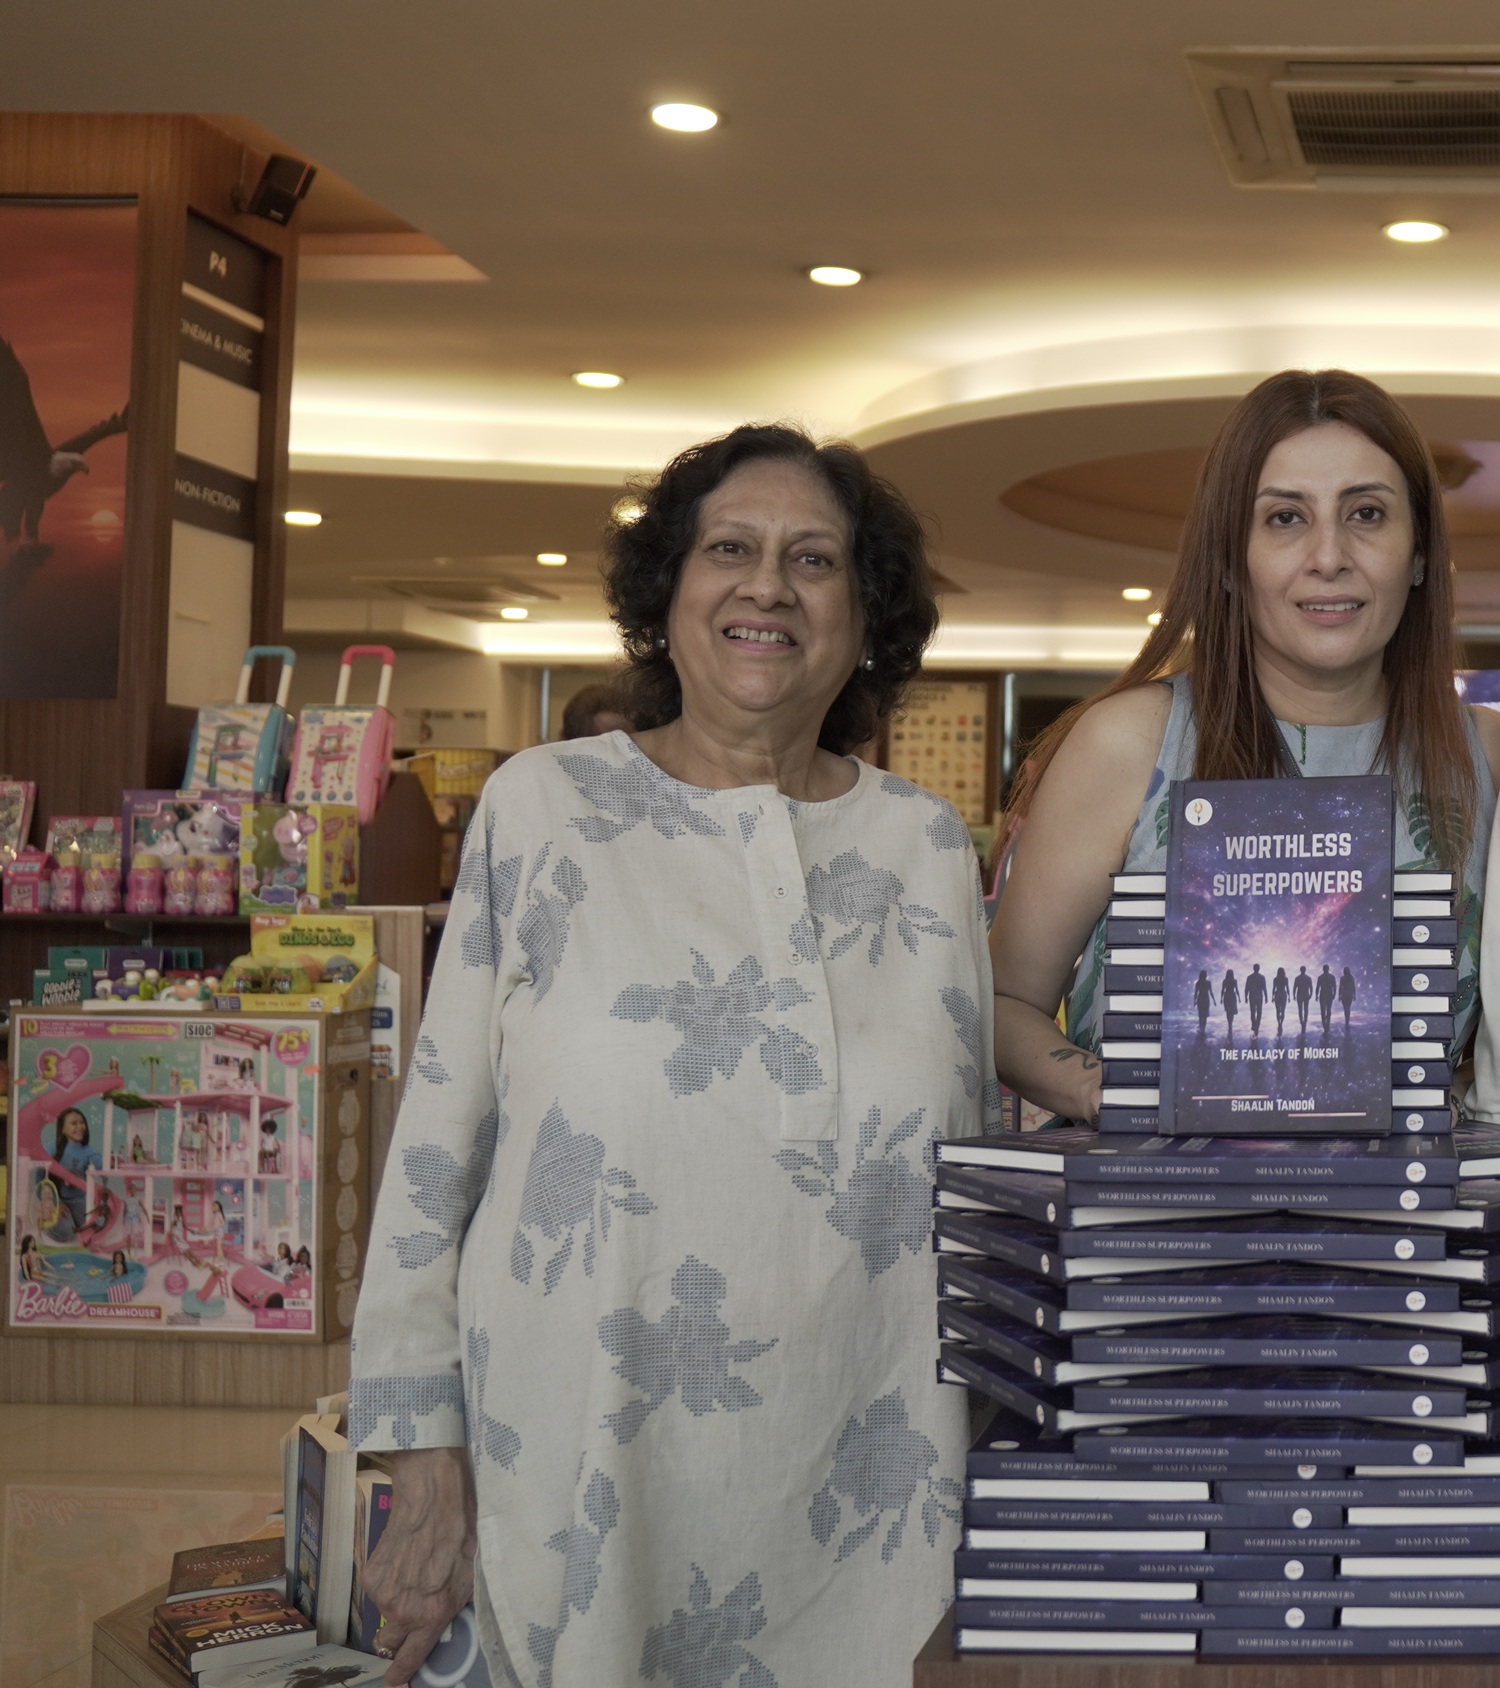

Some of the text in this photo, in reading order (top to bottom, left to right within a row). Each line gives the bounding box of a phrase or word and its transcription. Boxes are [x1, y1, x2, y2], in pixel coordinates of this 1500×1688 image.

[222, 339, 253, 366] MUSIC
[174, 478, 241, 512] NON-FICTION
[1225, 832, 1352, 860] WORTHLESS
[1213, 870, 1363, 897] SUPERPOWERS
[22, 1019, 38, 1035] 10
[1220, 1046, 1339, 1060] THE FALLACY OF MOKSH
[42, 1055, 58, 1079] 3
[1231, 1098, 1315, 1111] SHAALIN TANDON
[1098, 1165, 1334, 1175] WORTHLESS SUPERPOWERS SHAALIN TANDON
[1098, 1192, 1329, 1202] WORTHLESS SUPERPOWERS SHAALIN TANDON
[1093, 1240, 1324, 1251] WORTHLESS SUPERPOWERS SHAALIN TANDON
[18, 1280, 86, 1318] Barbie
[1103, 1295, 1335, 1304] WORTHLESS SUPERPOWERS SHAALIN TANDON
[89, 1306, 157, 1319] DREAMHOUSE
[1106, 1346, 1338, 1357] WORTHLESS SUPERPOWERS SHAALIN TANDON
[1110, 1397, 1341, 1408] WORTHLESS SUPERPOWERS SHAALIN TANDON
[1110, 1446, 1342, 1457] WORTHLESS SUPERPOWERS SHAALIN TANDON
[1247, 1488, 1474, 1498] WORTHLESS SUPERPOWERS SHAALIN TANDON
[996, 1511, 1224, 1522] WORTHLESS SUPERPOWERS SHAALIN TANDON
[1244, 1536, 1471, 1547] WORTHLESS SUPERPOWERS SHAALIN TANDON
[1238, 1590, 1465, 1599] WORTHLESS SUPERPOWERS SHAALIN TANDON
[170, 1593, 271, 1613] CLOWN
[196, 1623, 304, 1648] HERRON
[212, 1622, 280, 1639] MICK
[1237, 1638, 1464, 1648] WORTHLESS SUPERPOWERS SHAALIN TANDON
